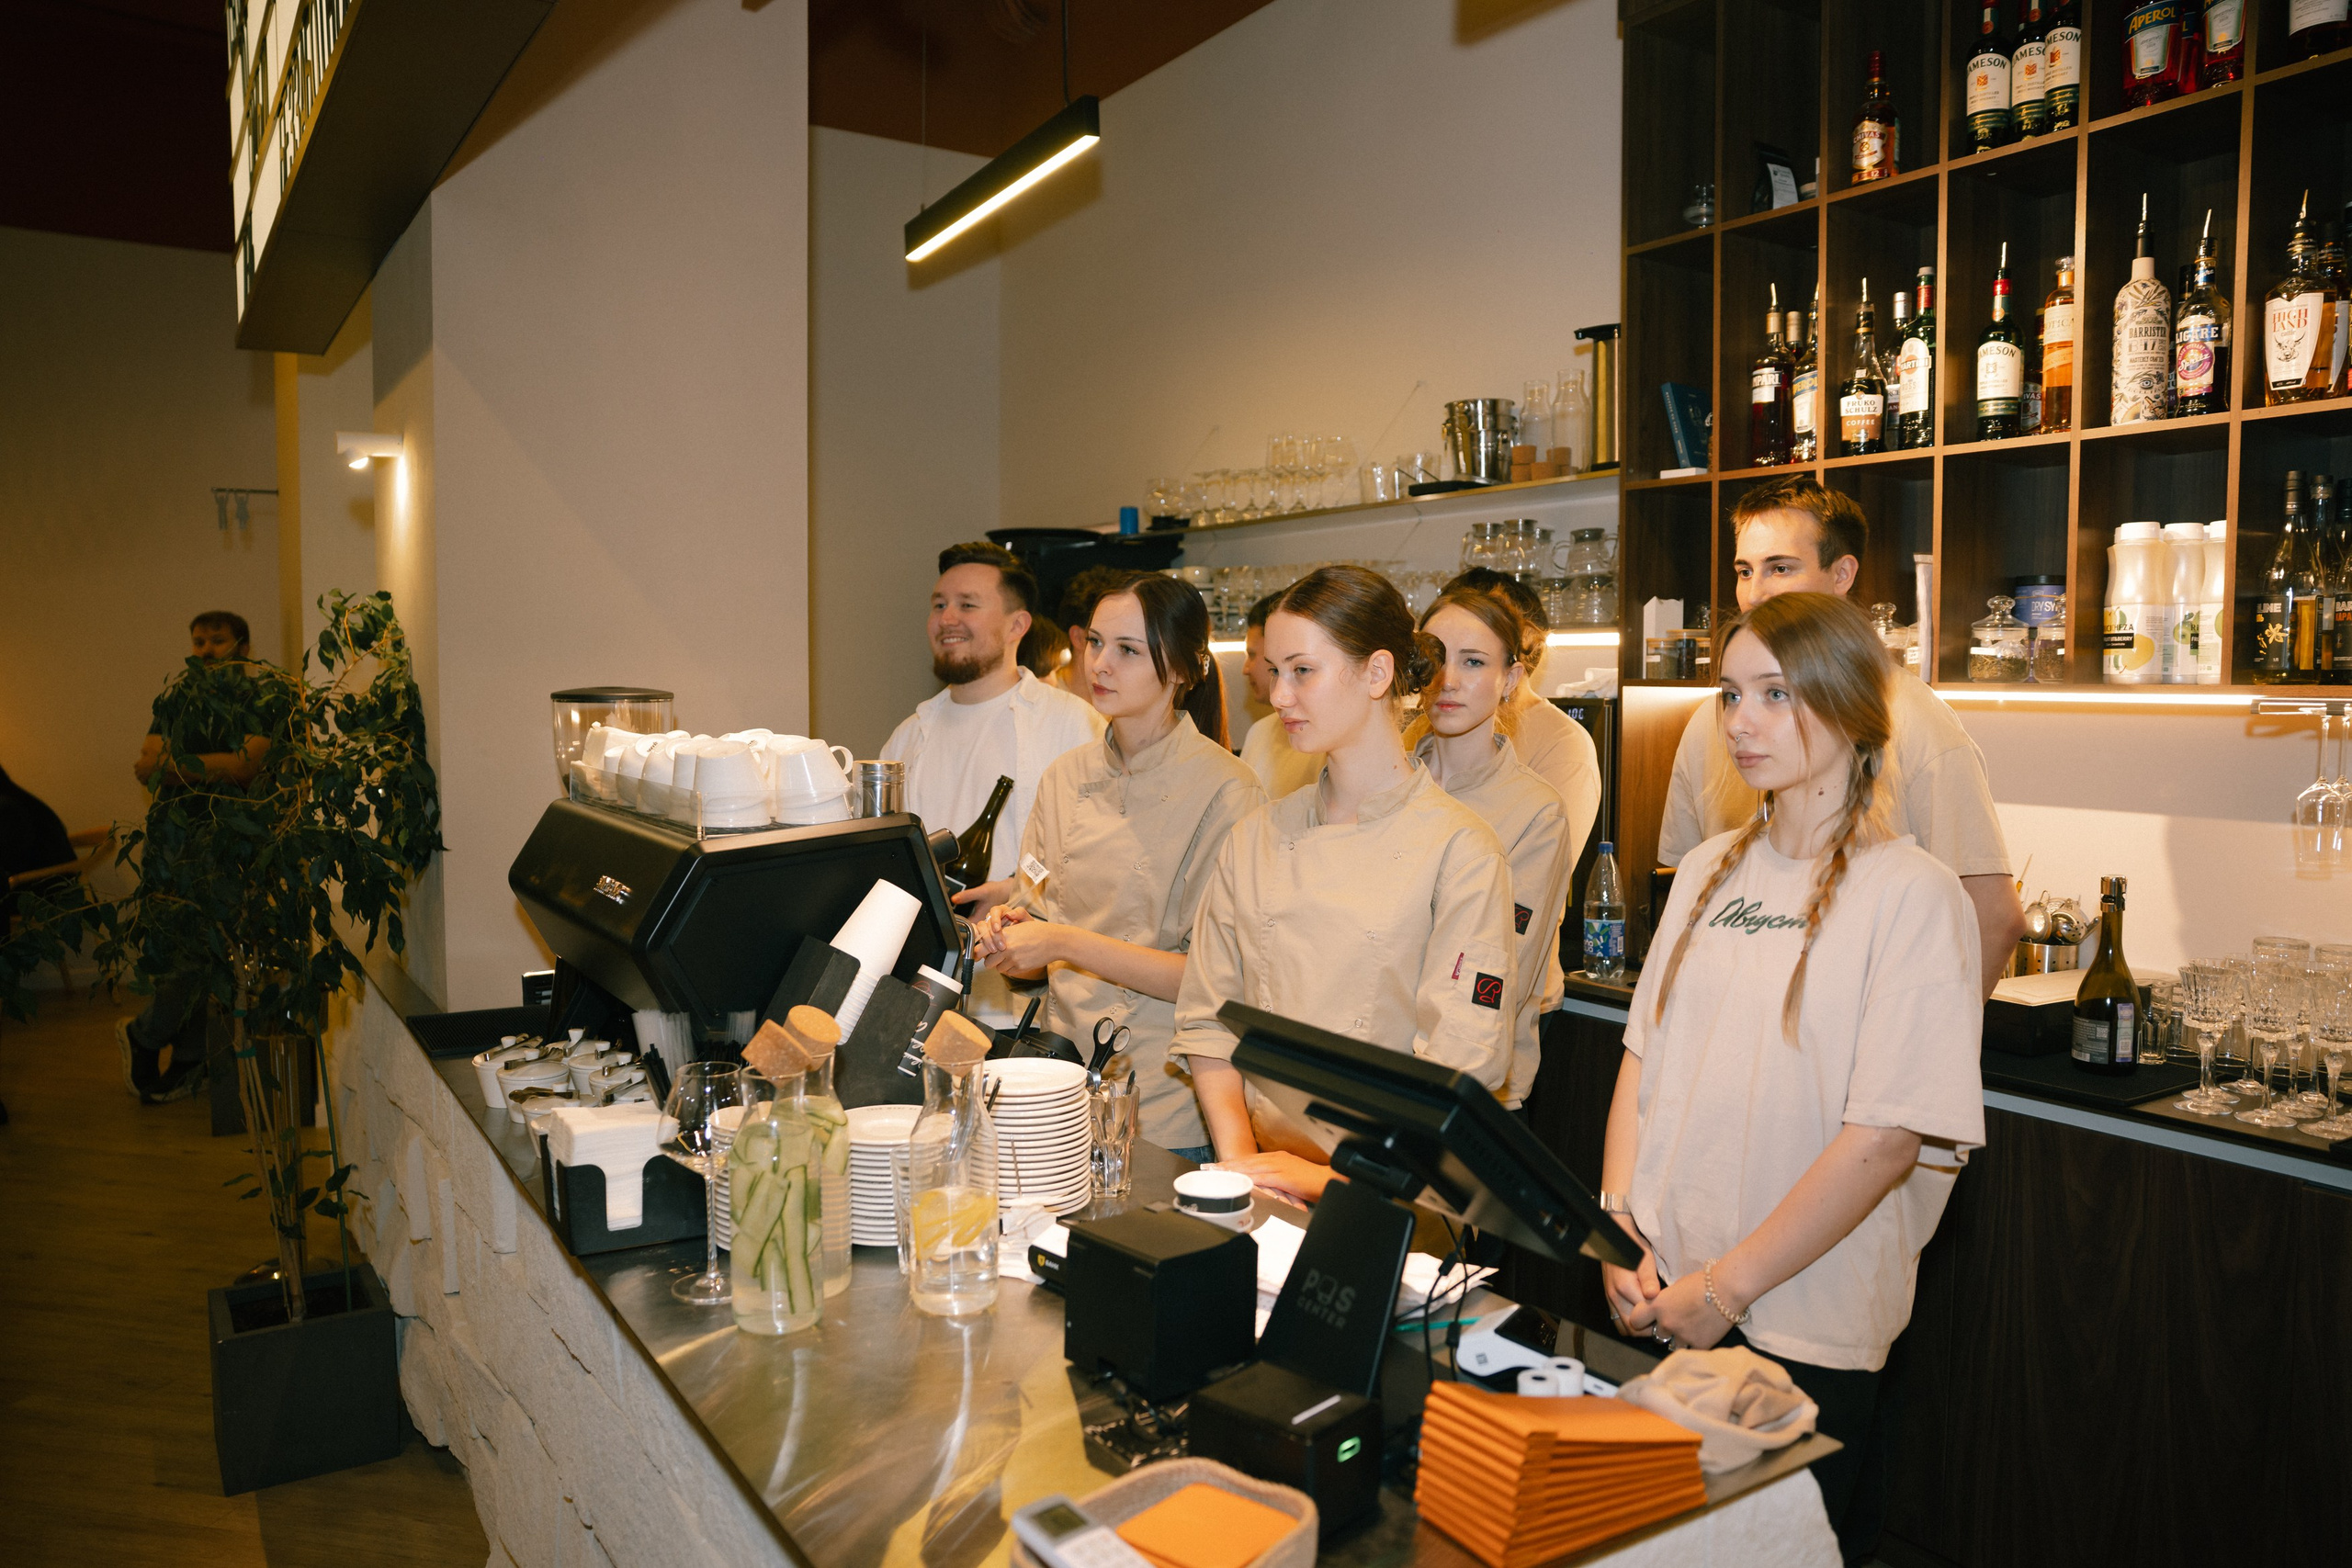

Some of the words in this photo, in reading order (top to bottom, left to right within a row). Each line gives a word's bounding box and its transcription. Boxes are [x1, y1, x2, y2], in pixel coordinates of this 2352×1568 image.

[2128, 7, 2177, 35] APEROL
[2045, 30, 2081, 47] MESON
[2012, 46, 2046, 68] AMESO
[1967, 57, 2007, 73] AMESON
[1853, 131, 1881, 143] CHIVAS
[2272, 308, 2308, 323] HIGH
[2129, 325, 2167, 338] BARRISTER
[2272, 318, 2308, 333] LAND
[1979, 345, 2017, 359] AMESON
[1752, 373, 1781, 388] MPARI
[2023, 391, 2041, 400] IVAS
[1845, 406, 1878, 414] SCHULZ
[1847, 400, 1876, 408] FRUKO
[2031, 601, 2044, 612] DRY
